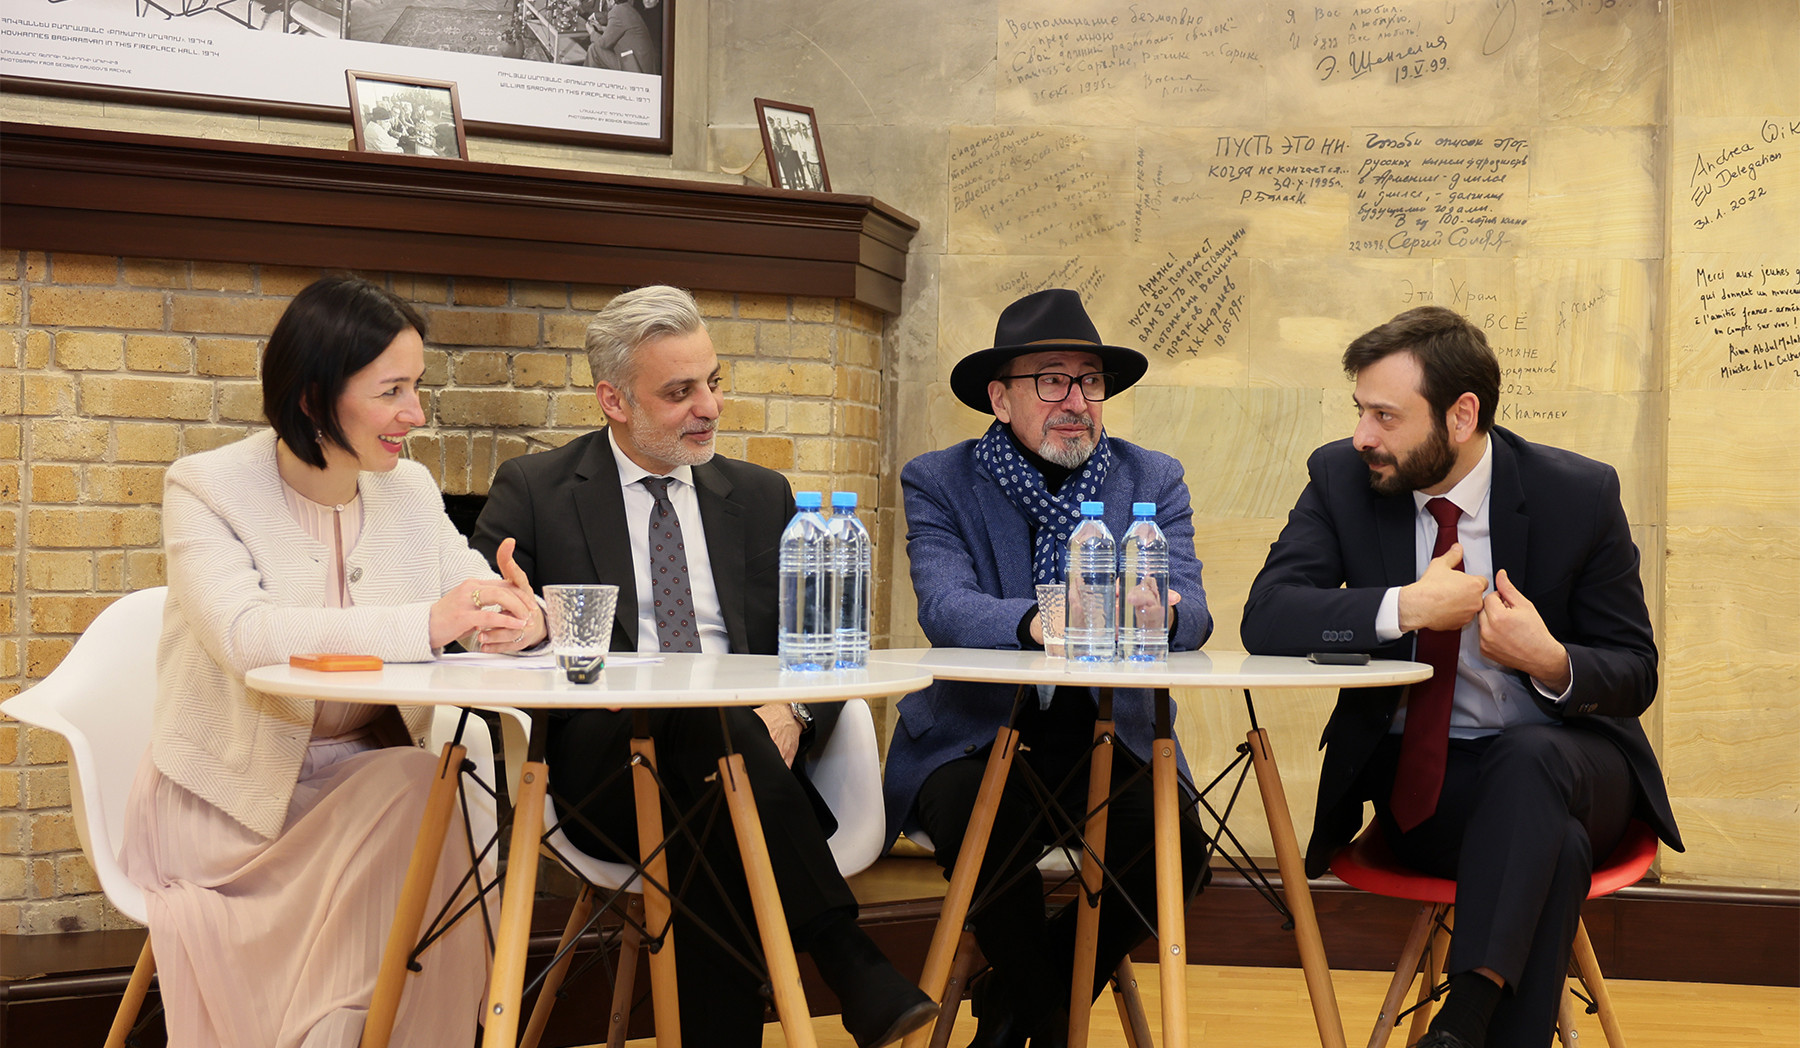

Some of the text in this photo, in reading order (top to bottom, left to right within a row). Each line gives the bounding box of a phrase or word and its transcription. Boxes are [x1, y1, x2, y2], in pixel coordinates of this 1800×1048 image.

[1285, 9, 1296, 24] Я
[0, 29, 50, 40] HOVHANNES
[51, 34, 104, 45] BAGHRAMYAN
[133, 43, 176, 53] FIREPLACE
[526, 85, 557, 93] SAROYAN
[580, 91, 616, 99] FIREPLACE
[1215, 134, 1273, 158] ПУСТЬ
[1281, 135, 1315, 155] ЭТО
[1690, 143, 1754, 188] Andrea
[1691, 152, 1782, 208] EU Delegation
[1696, 268, 1725, 287] Merci
[1735, 270, 1754, 279] aux
[1761, 264, 1790, 286] jeunes
[1449, 278, 1498, 310] Храм
[1700, 291, 1716, 310] qui
[1721, 288, 1753, 300] donnent
[1756, 289, 1768, 297] un
[1483, 312, 1528, 330] ВСЁ
[1720, 362, 1751, 379] Ministre
[1753, 359, 1763, 370] de
